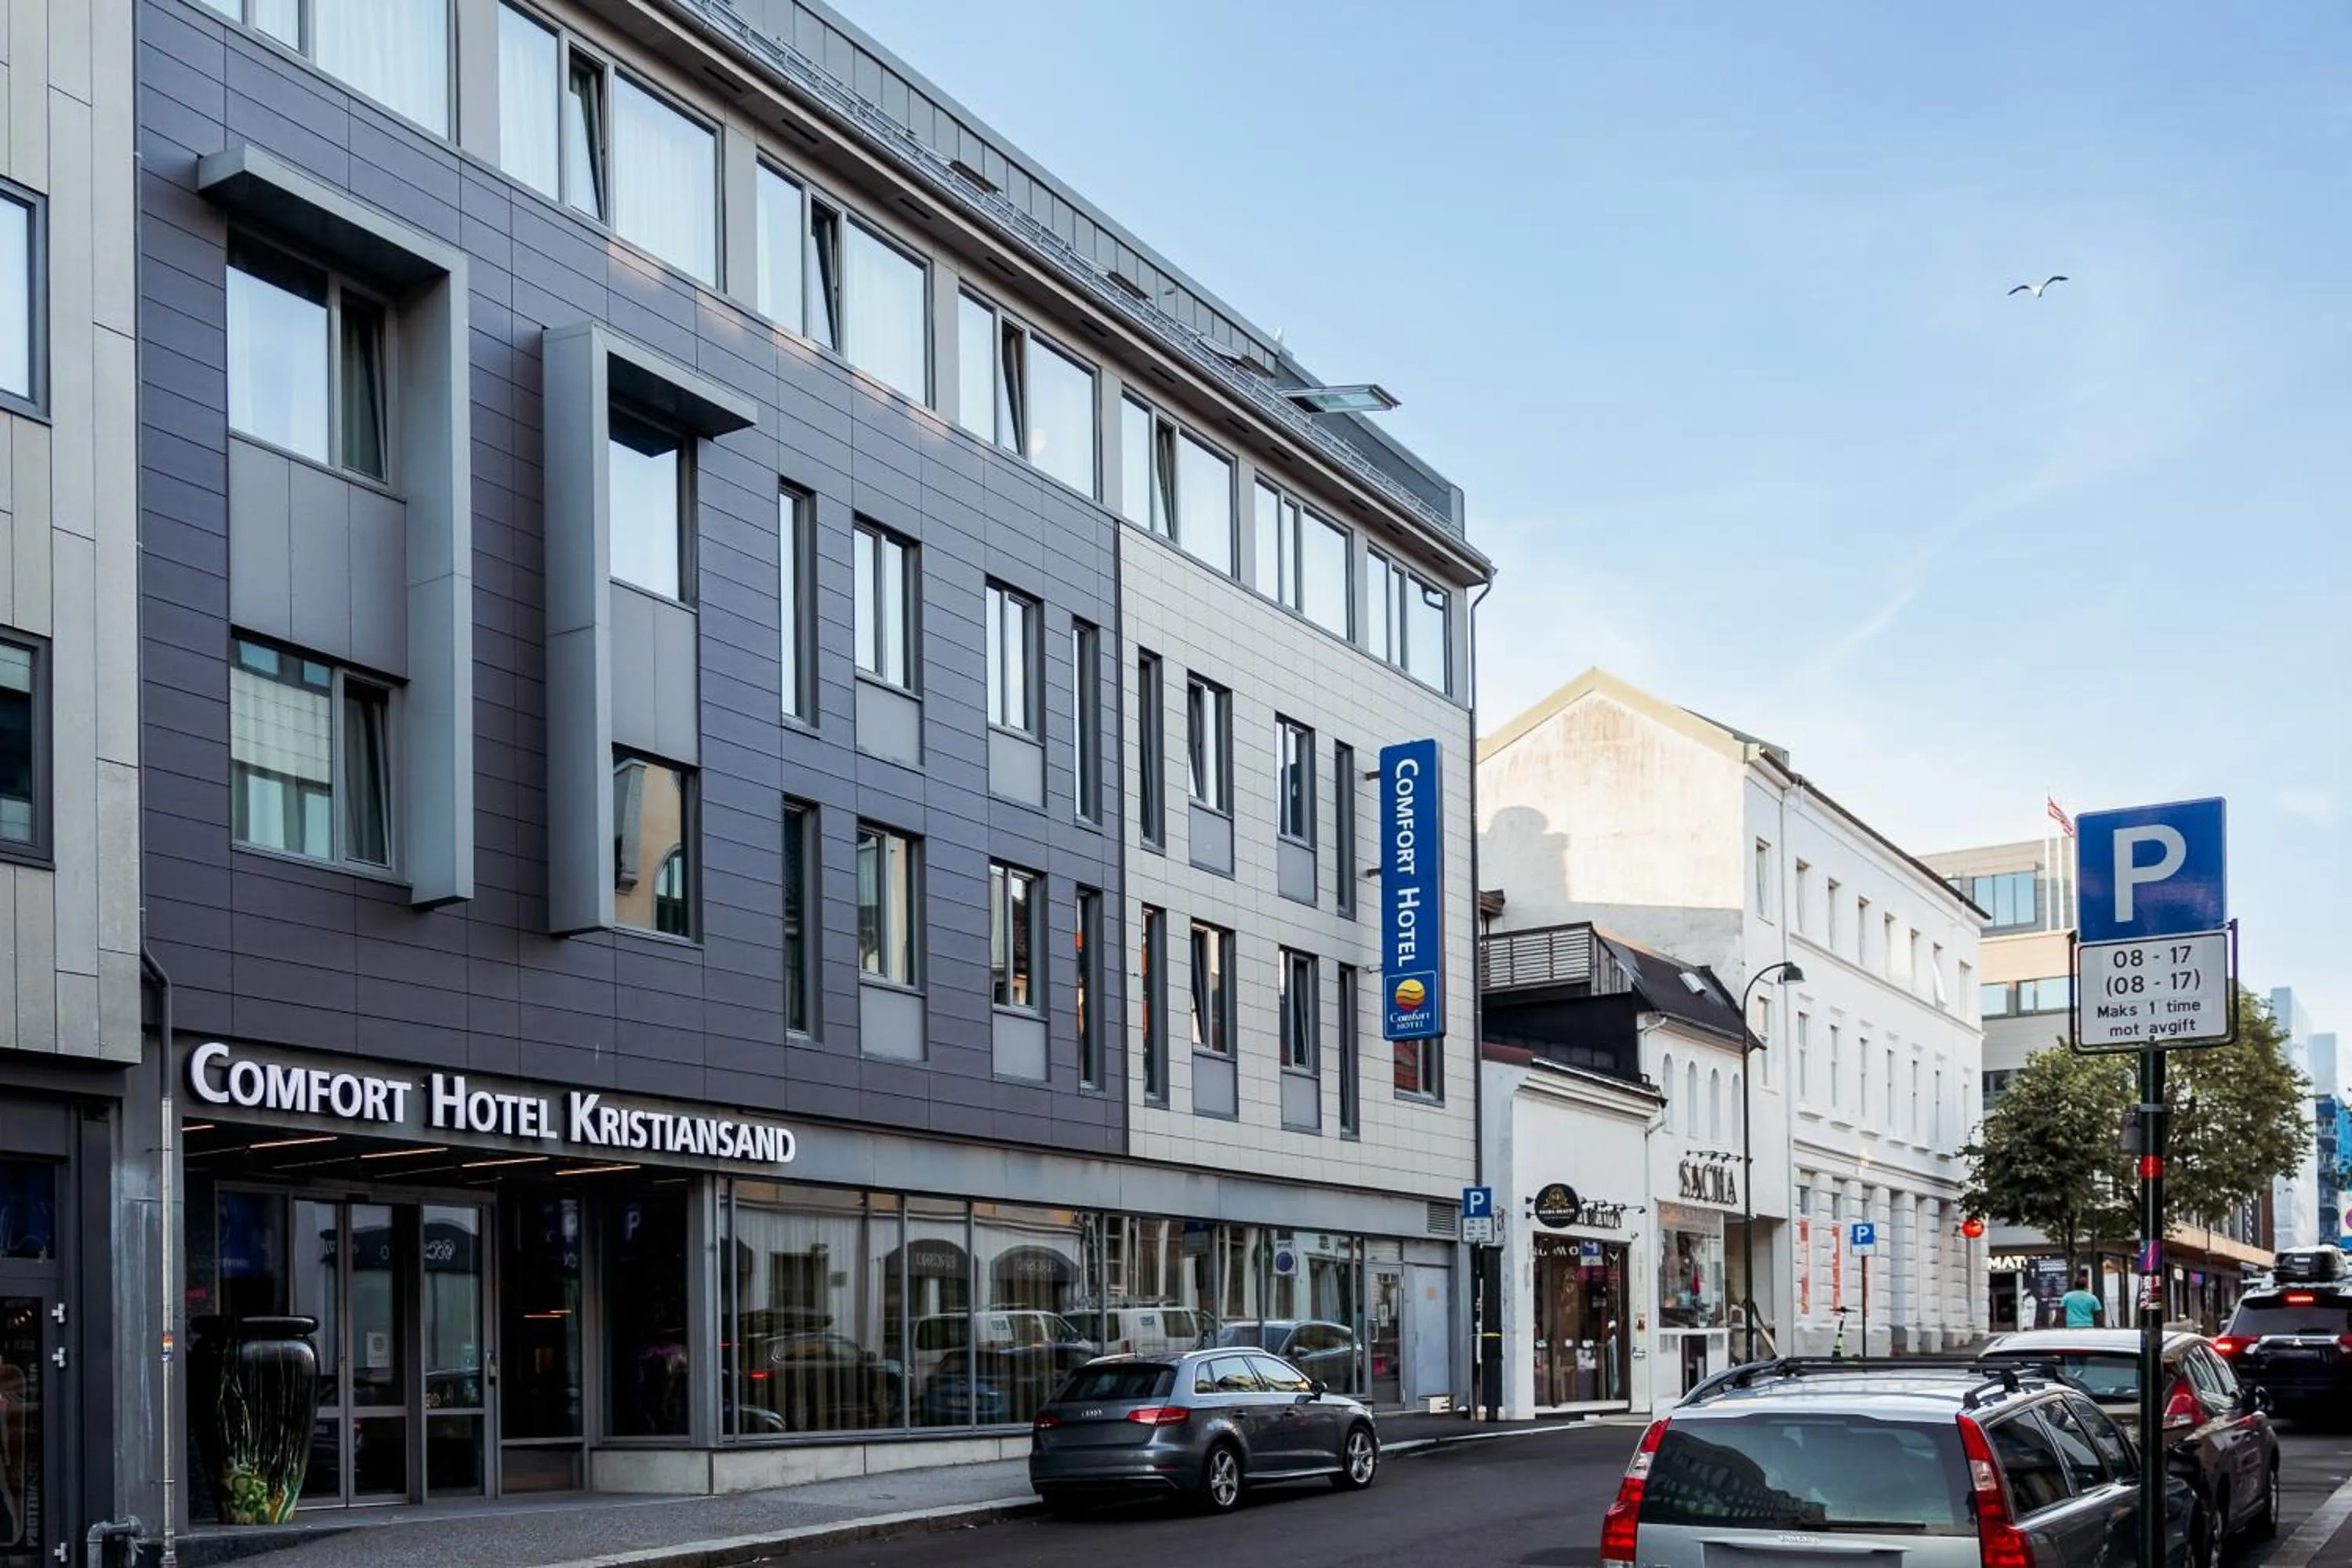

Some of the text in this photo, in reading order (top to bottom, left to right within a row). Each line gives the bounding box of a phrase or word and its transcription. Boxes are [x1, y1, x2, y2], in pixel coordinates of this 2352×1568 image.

[1396, 757, 1420, 967] COMFORT HOTEL
[2113, 824, 2187, 923] P
[2113, 949, 2143, 968] 08
[2170, 946, 2192, 964] 17
[2106, 976, 2145, 997] (08
[2171, 969, 2201, 991] 17)
[1390, 1010, 1430, 1023] Comfort
[2097, 1000, 2201, 1018] Maks 1 time
[2110, 1018, 2196, 1037] mot avgift
[190, 1042, 796, 1163] COMFORT HOTEL KRISTIANSAND
[1470, 1192, 1484, 1214] P
[1857, 1226, 1869, 1243] P
